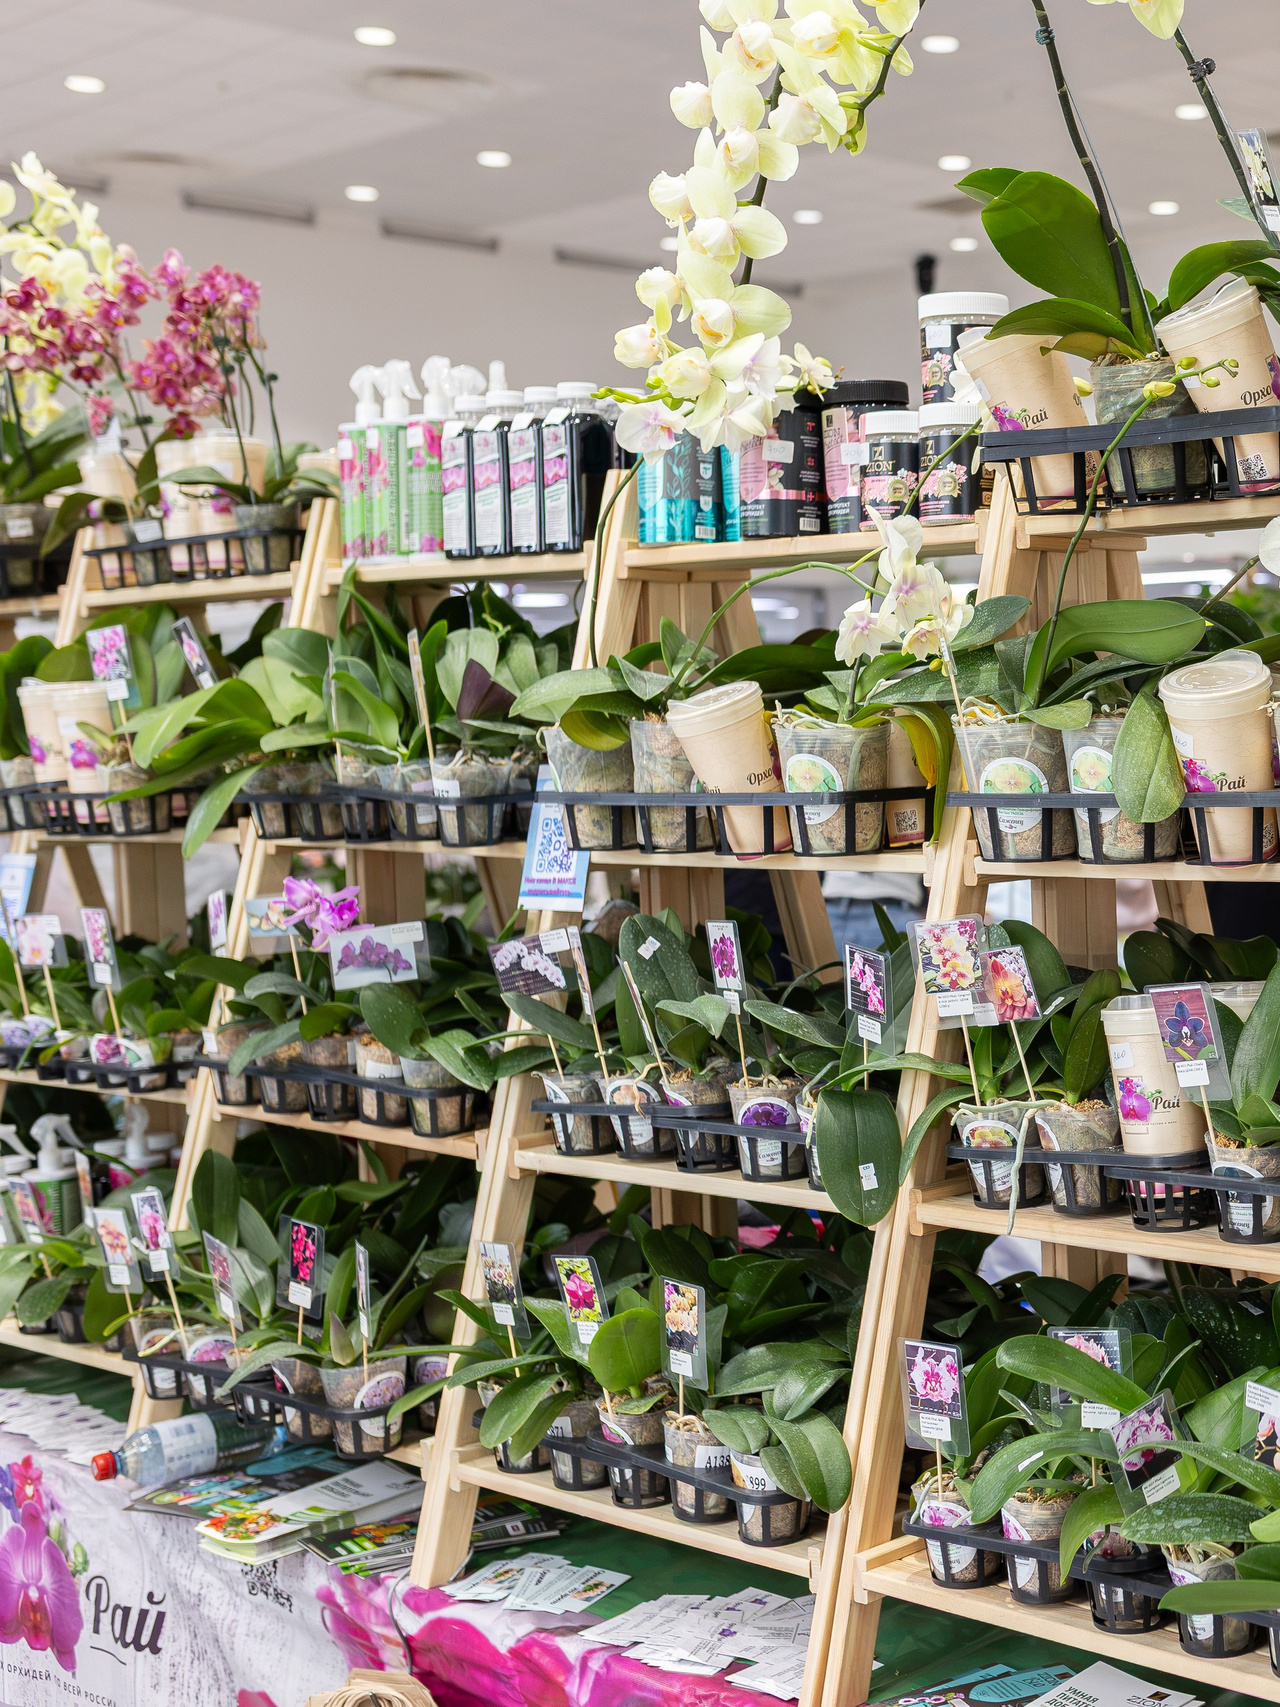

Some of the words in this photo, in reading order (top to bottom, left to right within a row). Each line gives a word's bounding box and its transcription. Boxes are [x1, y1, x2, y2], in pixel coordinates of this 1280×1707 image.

[1241, 385, 1272, 406] Орхо
[1022, 408, 1048, 428] Рай
[866, 461, 893, 473] ZION
[747, 767, 774, 788] Орхо
[1217, 774, 1247, 792] Рай
[1152, 1095, 1180, 1110] Рай
[86, 1575, 166, 1656] Рай
[7, 1663, 51, 1681] ОРХИДЕЙ
[63, 1681, 82, 1697] ВСЕЙ
[1065, 1686, 1099, 1703] УМНАЯ
